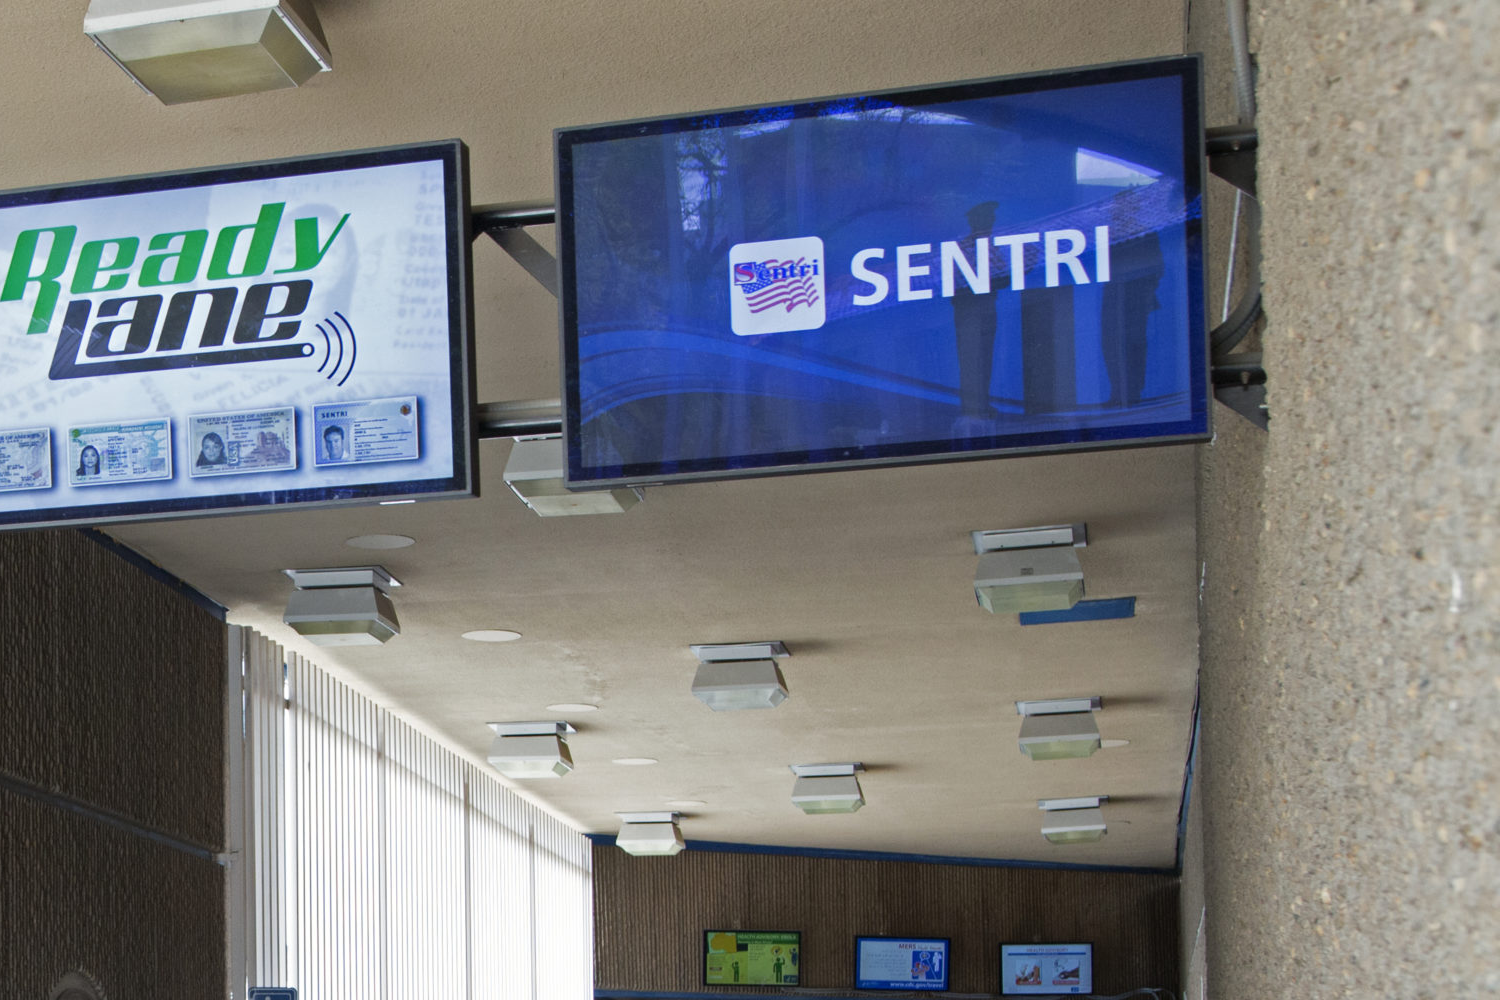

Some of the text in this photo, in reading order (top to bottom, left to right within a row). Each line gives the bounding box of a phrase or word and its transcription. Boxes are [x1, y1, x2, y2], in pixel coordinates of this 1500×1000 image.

[0, 201, 351, 335] Ready
[733, 225, 1111, 306] Sentri SENTRI
[48, 279, 315, 381] Lane
[321, 411, 348, 419] SENTRI
